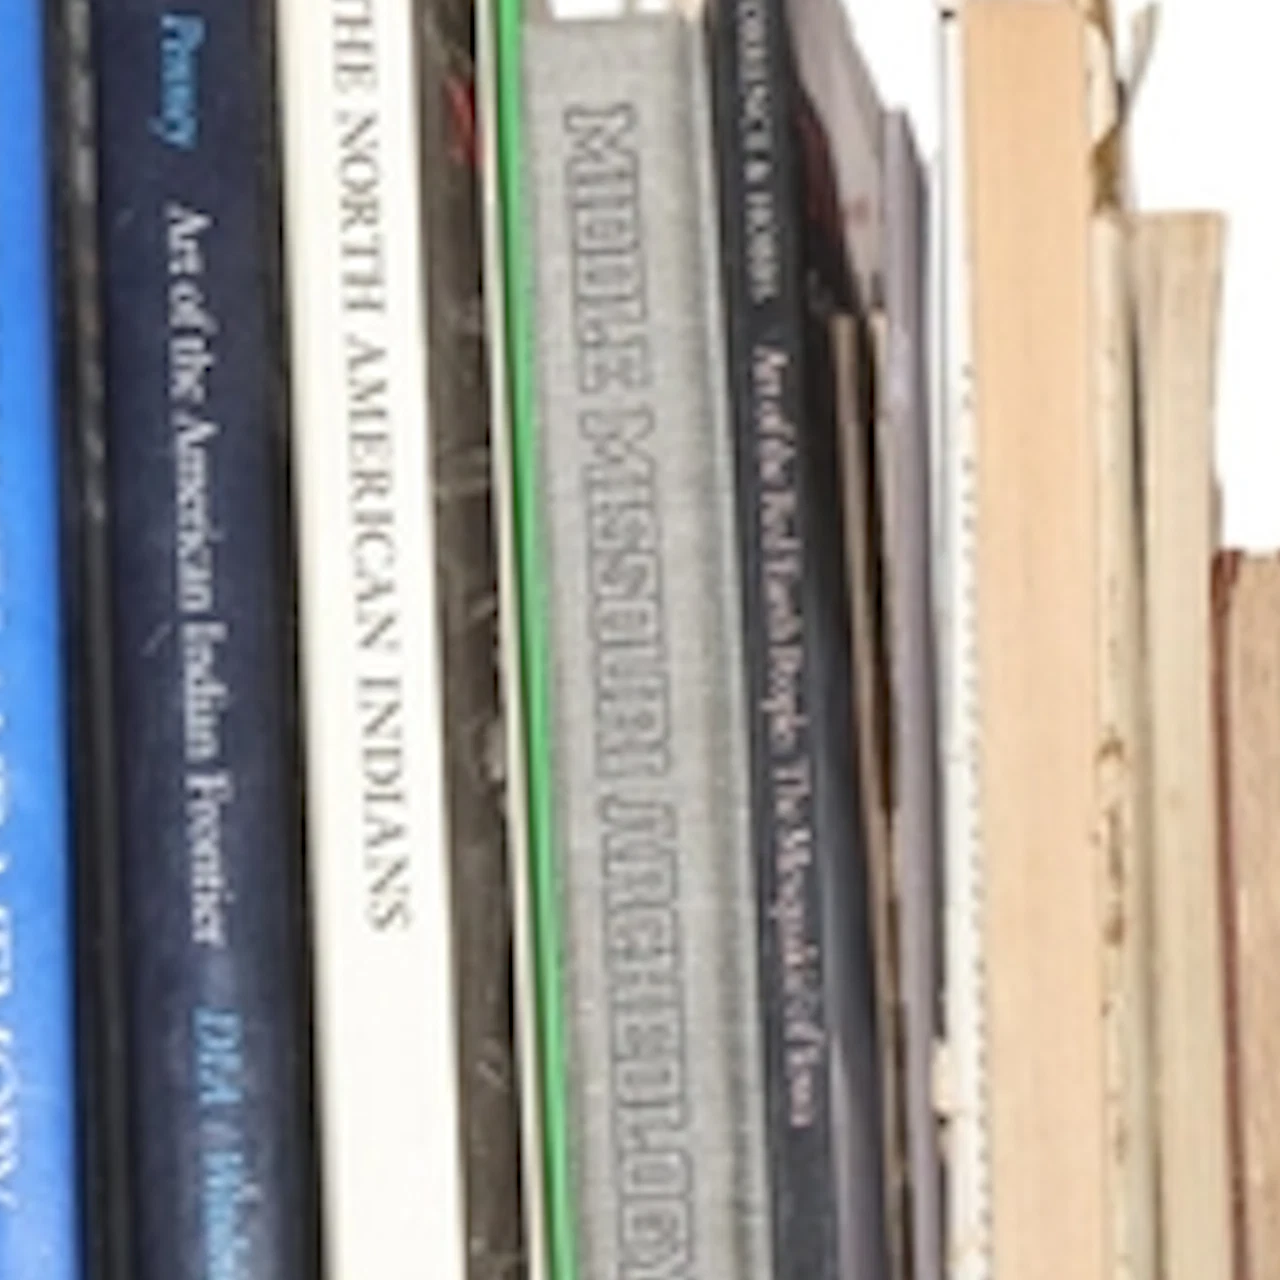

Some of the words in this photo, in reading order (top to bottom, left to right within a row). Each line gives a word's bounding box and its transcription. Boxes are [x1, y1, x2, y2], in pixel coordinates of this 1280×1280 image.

[148, 13, 207, 151] Penney
[165, 205, 212, 276] Art
[337, 110, 386, 315] NORTH
[563, 101, 653, 394] MIDDLE
[168, 282, 218, 333] of
[169, 335, 214, 405] the
[751, 342, 789, 397] Art
[757, 401, 797, 438] of
[759, 437, 800, 486] the
[172, 410, 223, 613] American
[346, 330, 404, 652] AMERICAN
[760, 489, 803, 552] Red
[578, 406, 672, 780] MISSOURI
[764, 555, 804, 650] Earth
[179, 622, 231, 762] Indian
[358, 675, 412, 932] INDIANS
[772, 758, 813, 814] The
[183, 772, 236, 948] Frontier
[784, 1007, 826, 1045] of
[786, 1045, 818, 1129] Iowa
